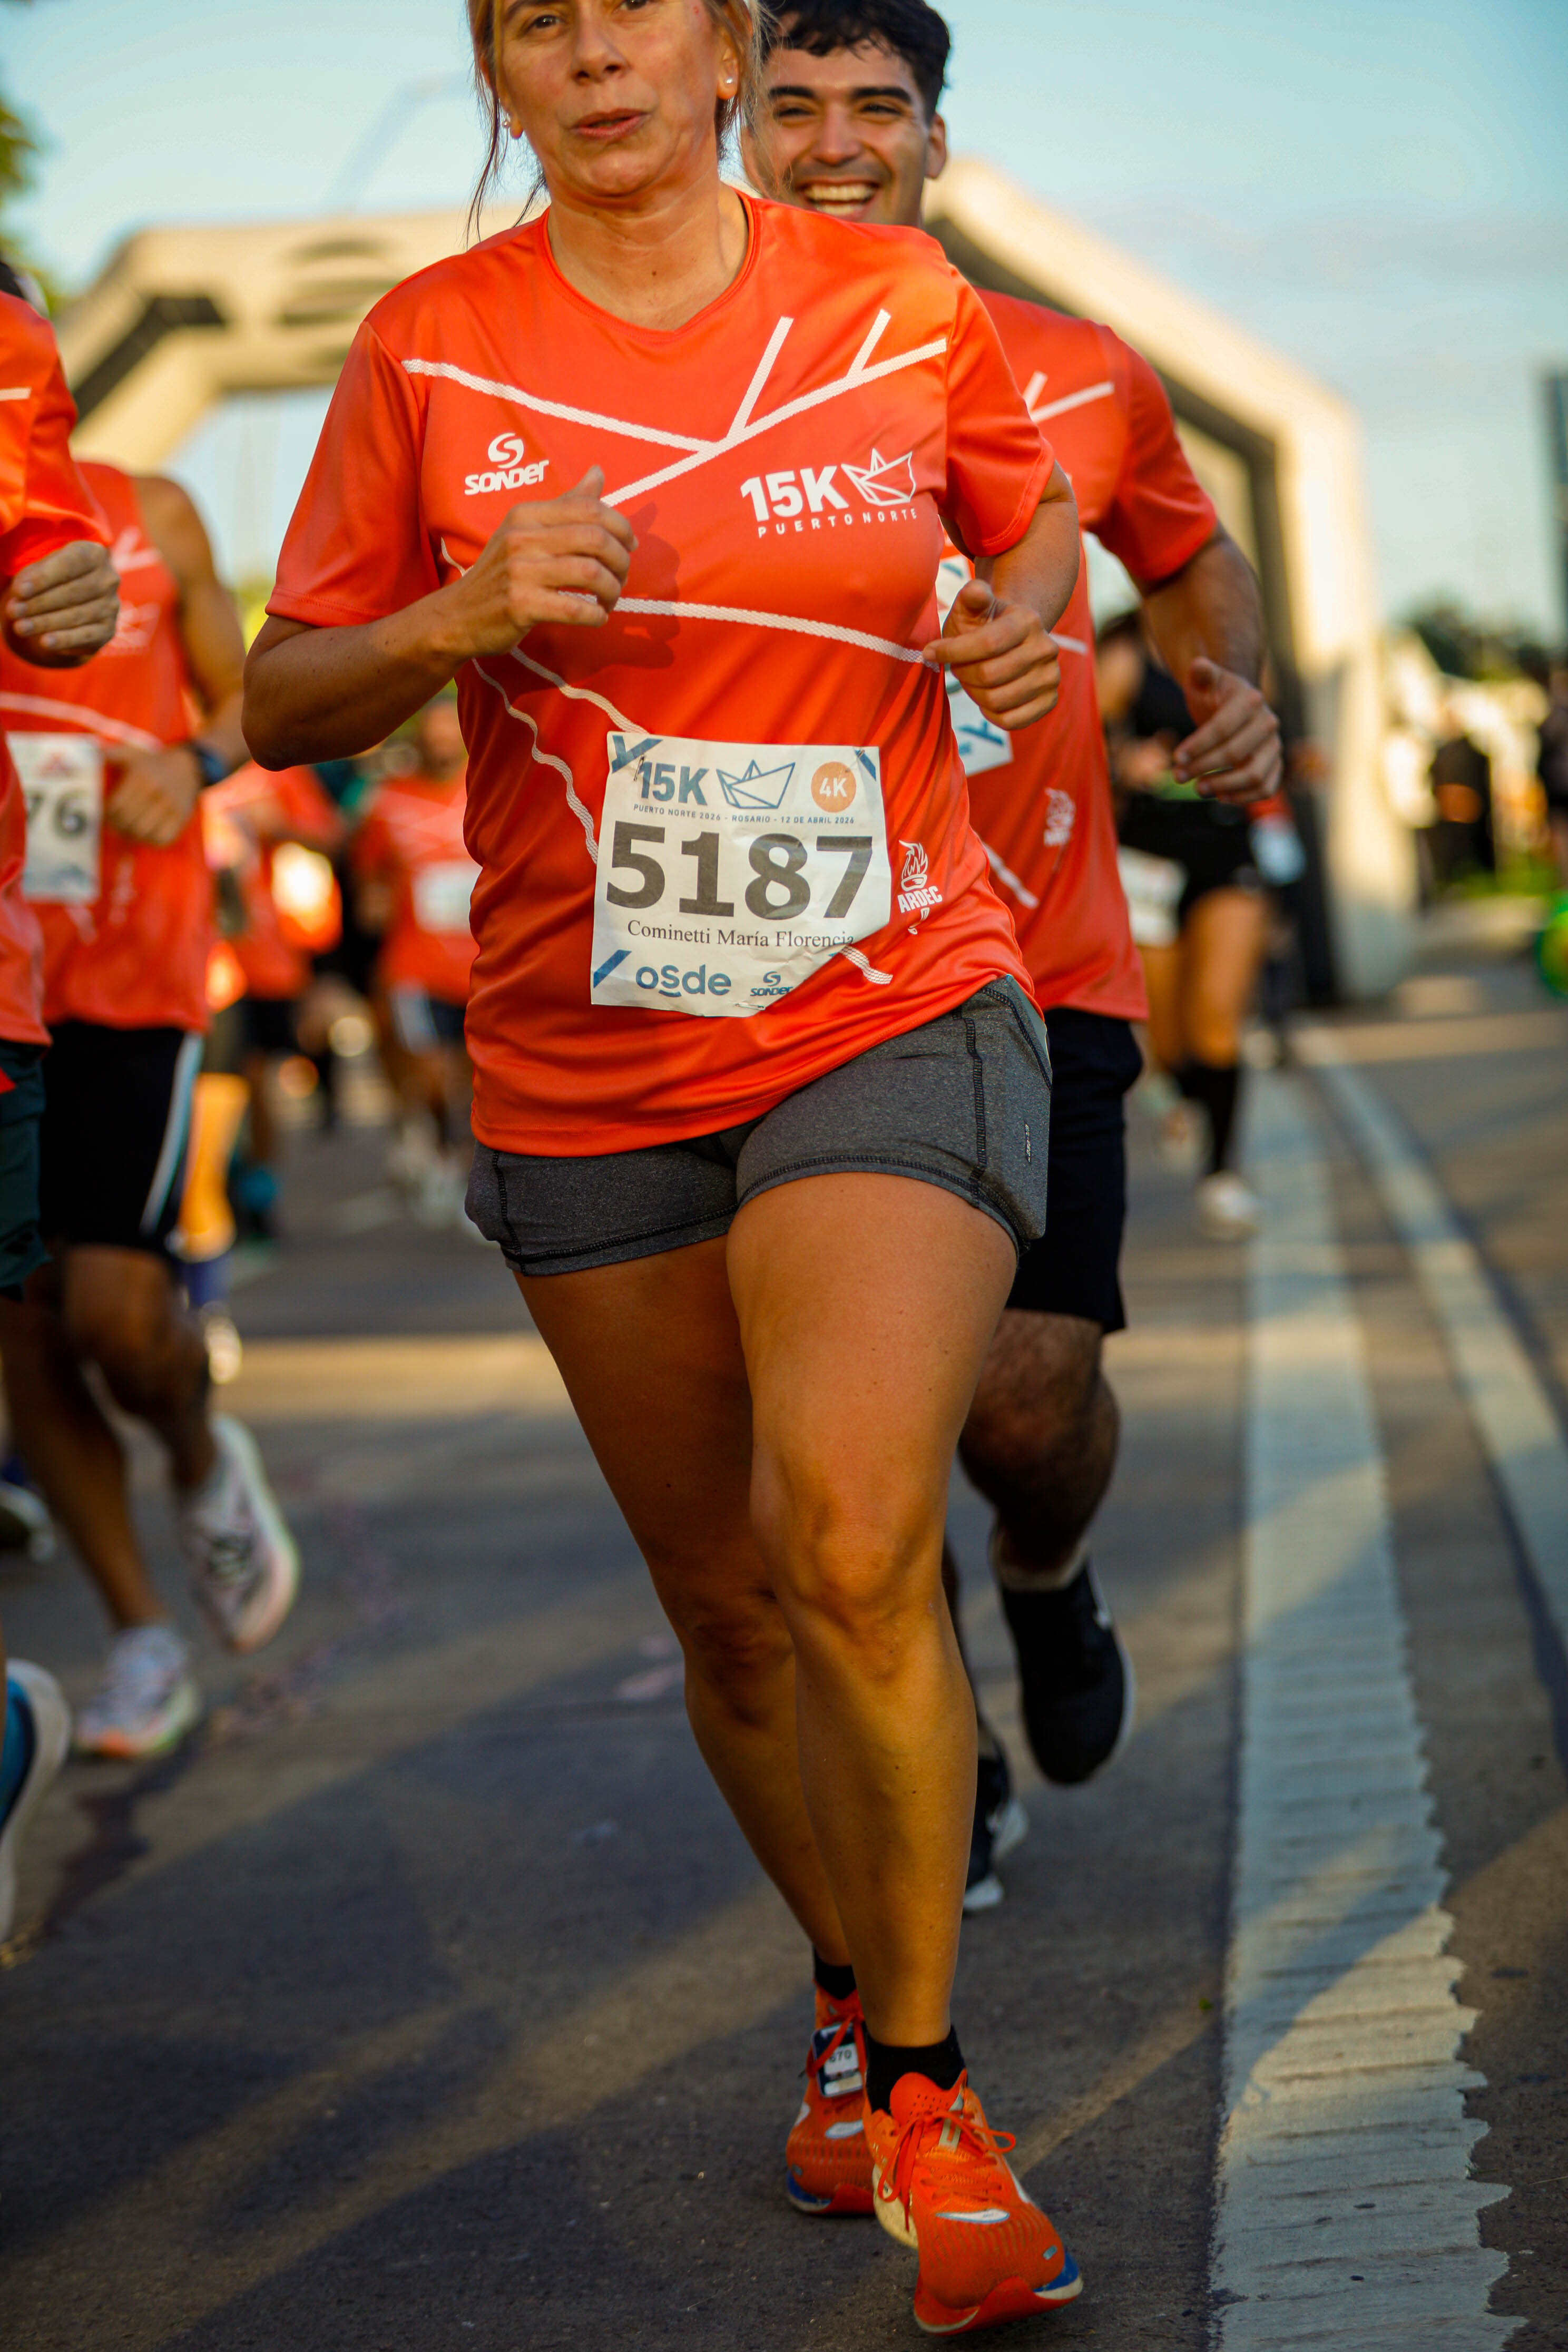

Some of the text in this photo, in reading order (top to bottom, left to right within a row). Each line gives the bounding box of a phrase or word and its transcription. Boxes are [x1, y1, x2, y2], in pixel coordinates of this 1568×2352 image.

[740, 465, 849, 523] 15K
[758, 507, 917, 538] PUERTO NORTE
[638, 761, 710, 806] 15K
[819, 777, 847, 798] 4K
[633, 803, 664, 815] PUERTO
[668, 809, 696, 818] NORTE
[700, 812, 721, 821] 2026
[606, 820, 873, 920] 5187
[897, 886, 943, 914] ARDEC
[627, 919, 854, 947] Cominetti María Florencia
[635, 964, 732, 997] osde
